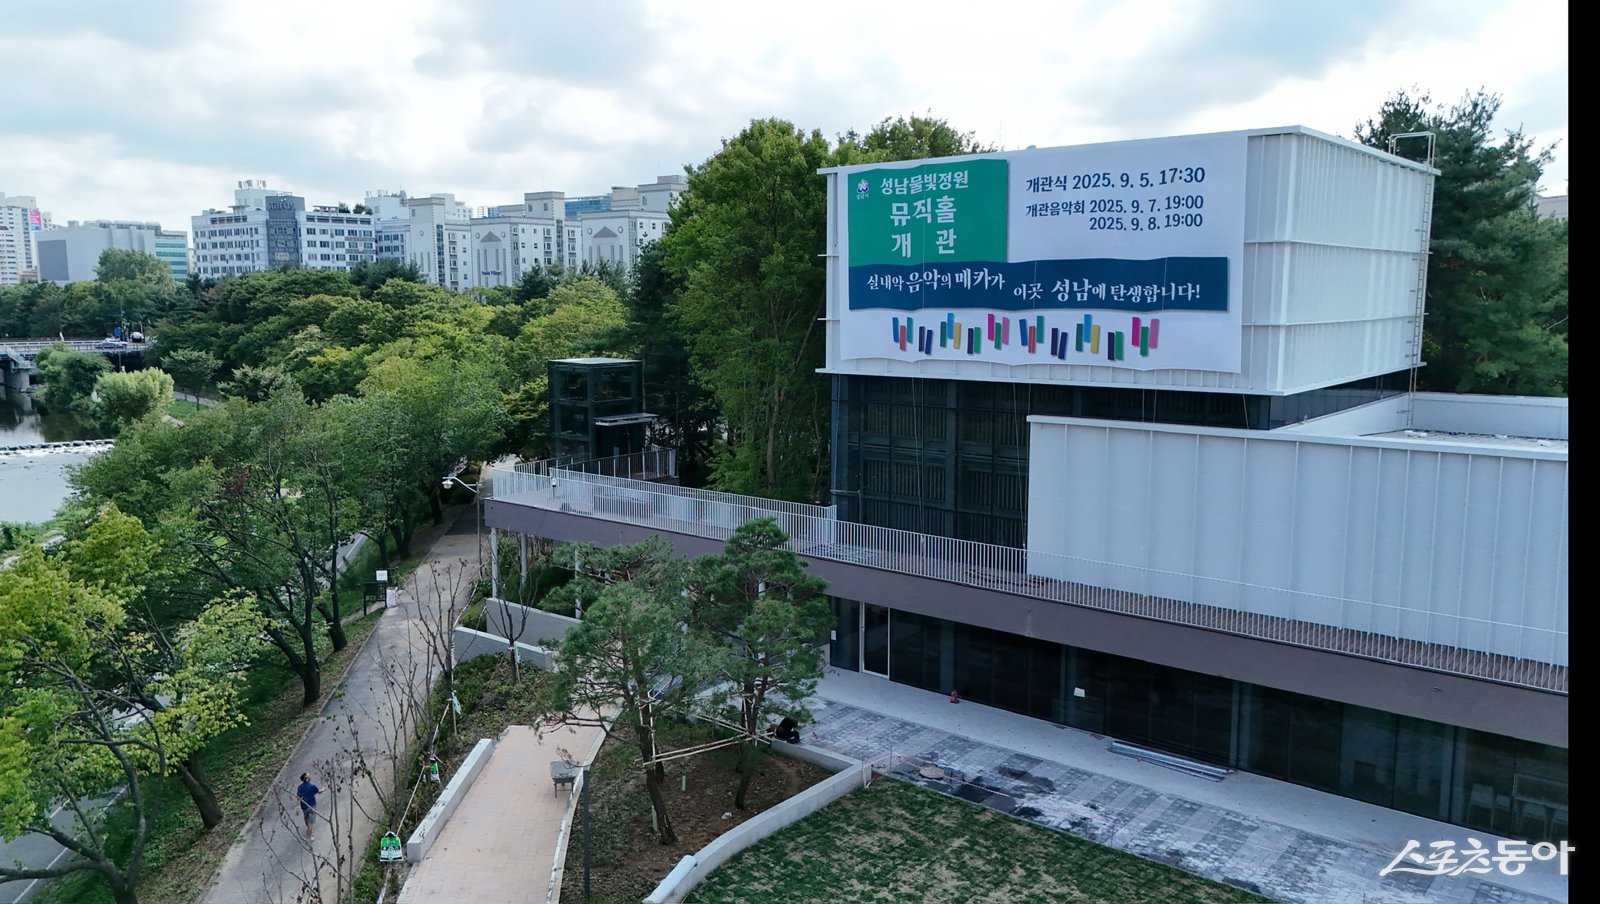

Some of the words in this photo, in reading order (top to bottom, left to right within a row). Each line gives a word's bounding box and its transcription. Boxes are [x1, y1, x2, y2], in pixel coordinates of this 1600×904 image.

[880, 170, 969, 195] 성남물빛정원
[1026, 175, 1068, 193] 개관식
[1072, 173, 1115, 190] 2025.
[1120, 173, 1134, 188] 9.
[1139, 172, 1154, 188] 5.
[1158, 167, 1205, 185] 17:30
[890, 195, 957, 227] 뮤직홀
[1025, 201, 1085, 218] 개관음악회
[1089, 199, 1127, 215] 2025.
[1131, 198, 1145, 215] 9.
[1148, 198, 1161, 213] 7.
[1164, 195, 1204, 210] 19:00
[1089, 216, 1127, 231] 2025.
[1131, 217, 1144, 231] 9.
[1147, 215, 1161, 230] 8.
[1164, 214, 1203, 228] 19:00
[866, 274, 904, 291] 실내악
[906, 269, 952, 292] 음악의
[954, 268, 1005, 291] 메카가
[1014, 284, 1043, 301] 이곳
[1051, 279, 1106, 302] 성남에
[1110, 283, 1201, 303] 탄생합니다!
